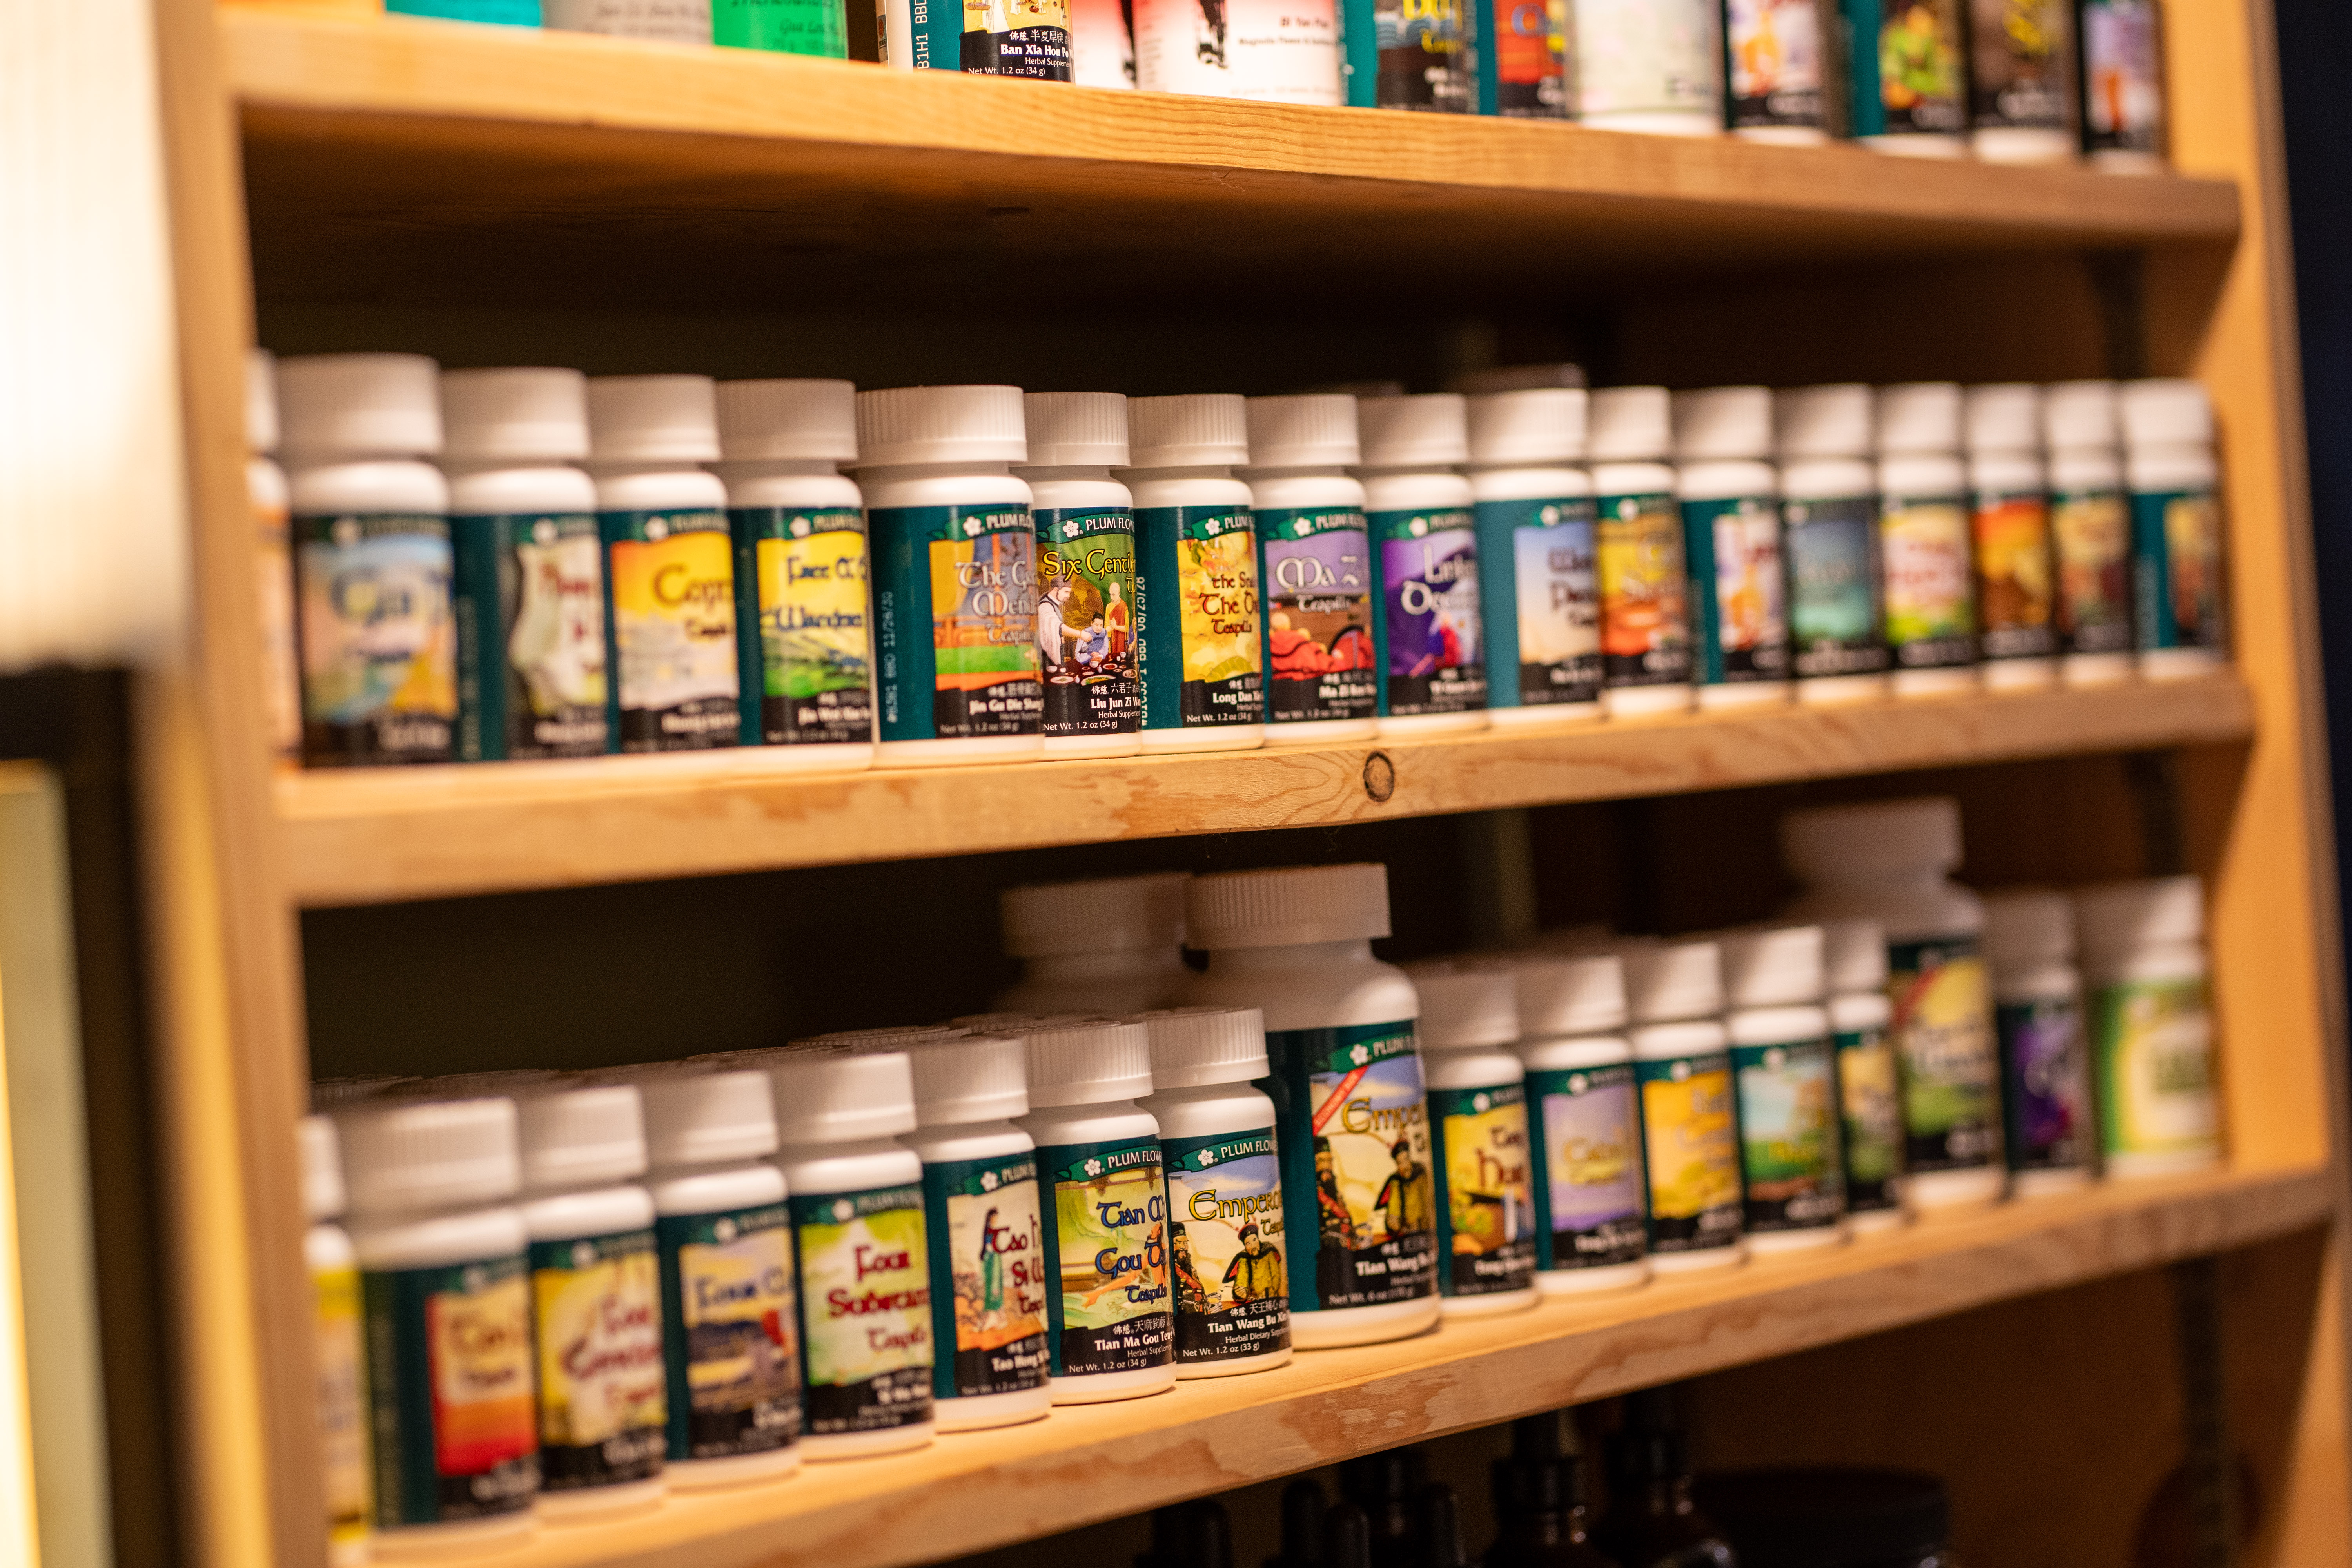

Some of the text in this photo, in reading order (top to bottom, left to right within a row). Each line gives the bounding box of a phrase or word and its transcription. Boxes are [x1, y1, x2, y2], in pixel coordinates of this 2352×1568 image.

[1001, 44, 1069, 58] Ban Xia Hou Po
[1026, 67, 1037, 75] (34
[1039, 67, 1045, 76] g)
[1086, 517, 1116, 531] PLUM
[1042, 550, 1083, 582] Six
[955, 561, 1006, 588] The
[1199, 592, 1239, 615] The
[1091, 698, 1106, 708] Liu
[1109, 698, 1123, 710] Jun
[1125, 697, 1132, 707] Zi
[1213, 692, 1238, 705] Long
[1238, 691, 1253, 703] Dan
[1100, 720, 1110, 729] (34
[1112, 720, 1118, 729] g)
[1220, 1142, 1254, 1158] PLUM
[1107, 1151, 1140, 1168] PLUM
[1096, 1201, 1145, 1228] Tian
[1095, 1247, 1143, 1280] Gou
[1207, 1322, 1233, 1334] Tian
[1236, 1319, 1265, 1330] Wang
[1266, 1315, 1277, 1326] Bu
[1094, 1330, 1173, 1351] Tian Ma Gou Teng
[1225, 1334, 1249, 1344] Herbal
[1127, 1347, 1148, 1358] Herbal
[1216, 1346, 1228, 1354] 1.2
[1240, 1342, 1252, 1352] (34
[1085, 1363, 1100, 1371] Wt.
[1103, 1361, 1115, 1370] 1.2
[1127, 1359, 1139, 1368] (34
[1140, 1357, 1147, 1368] g)
